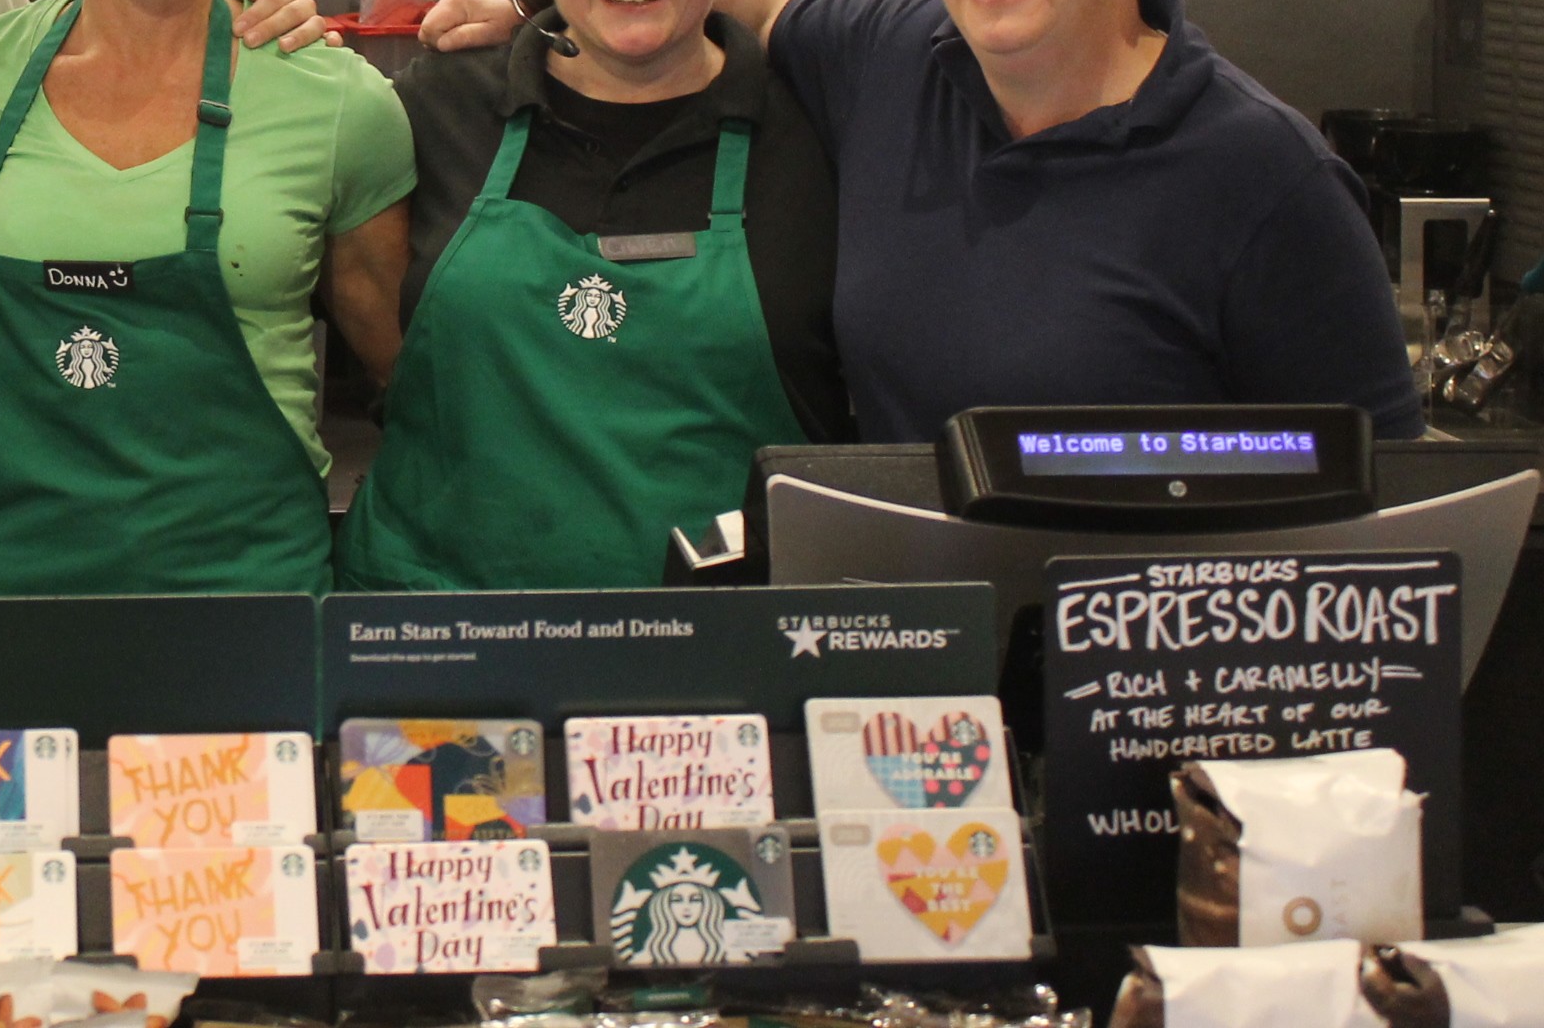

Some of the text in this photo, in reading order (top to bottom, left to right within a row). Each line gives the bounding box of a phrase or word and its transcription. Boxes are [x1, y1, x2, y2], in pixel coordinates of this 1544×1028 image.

[1019, 432, 1313, 455] Welcome to Starbucks
[1147, 560, 1299, 587] STARBUCKS
[350, 619, 694, 641] Earn Stars Toward Food and Drinks
[1057, 584, 1456, 652] ESPRESSO ROAST
[828, 629, 947, 650] REWARDS
[1107, 657, 1382, 698] RICH + CARAMELLY
[1090, 699, 1389, 732] AT THE HEART OF OUR
[611, 723, 713, 759] Happy
[1110, 730, 1372, 762] HANDCRAFTED LATTE
[125, 734, 251, 805] THANK
[584, 758, 756, 806] Valentine's
[157, 796, 239, 848] YOU
[1087, 808, 1179, 836] WHOL
[130, 848, 256, 920] THANK
[388, 849, 493, 884] Happy
[361, 884, 538, 930] Valentine's
[159, 910, 242, 972] YOU
[414, 930, 485, 966] Day
